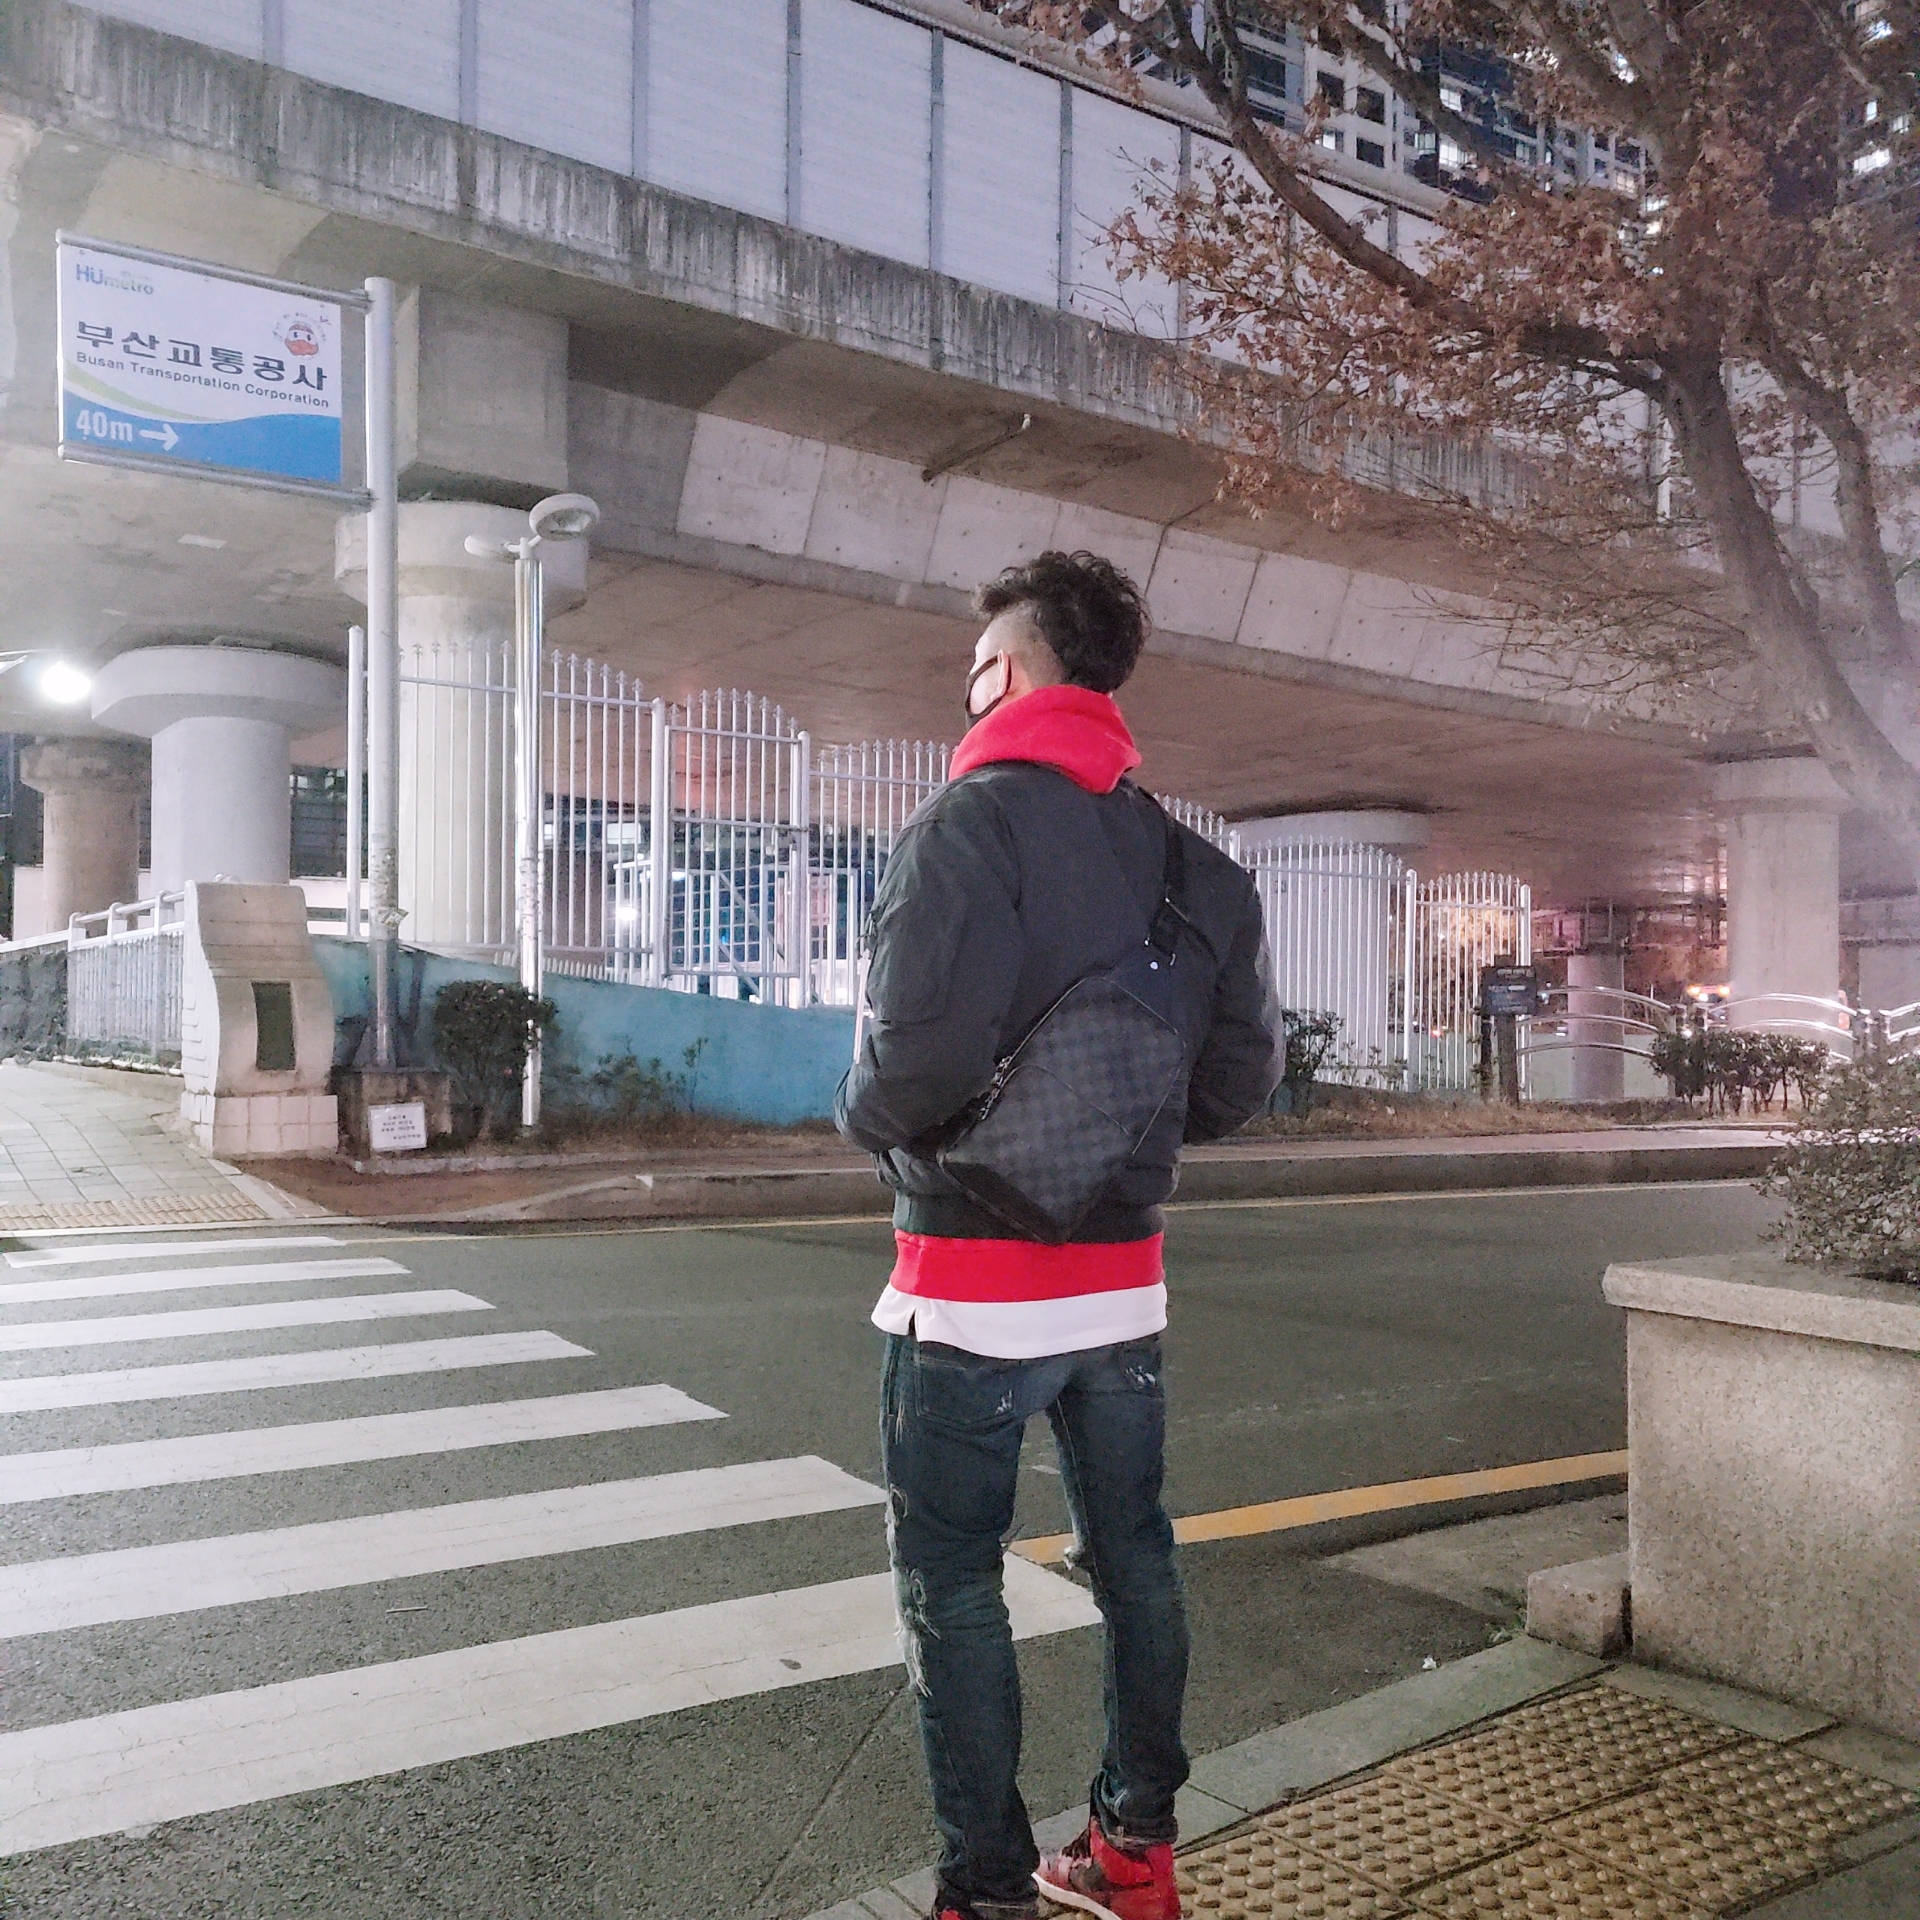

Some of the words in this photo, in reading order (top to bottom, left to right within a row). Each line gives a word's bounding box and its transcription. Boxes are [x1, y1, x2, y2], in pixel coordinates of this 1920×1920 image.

[76, 321, 328, 391] 부산교통공사
[76, 351, 125, 370] Busan
[130, 361, 240, 392] Transportation
[245, 383, 329, 408] Corporation
[76, 409, 133, 442] 40m
